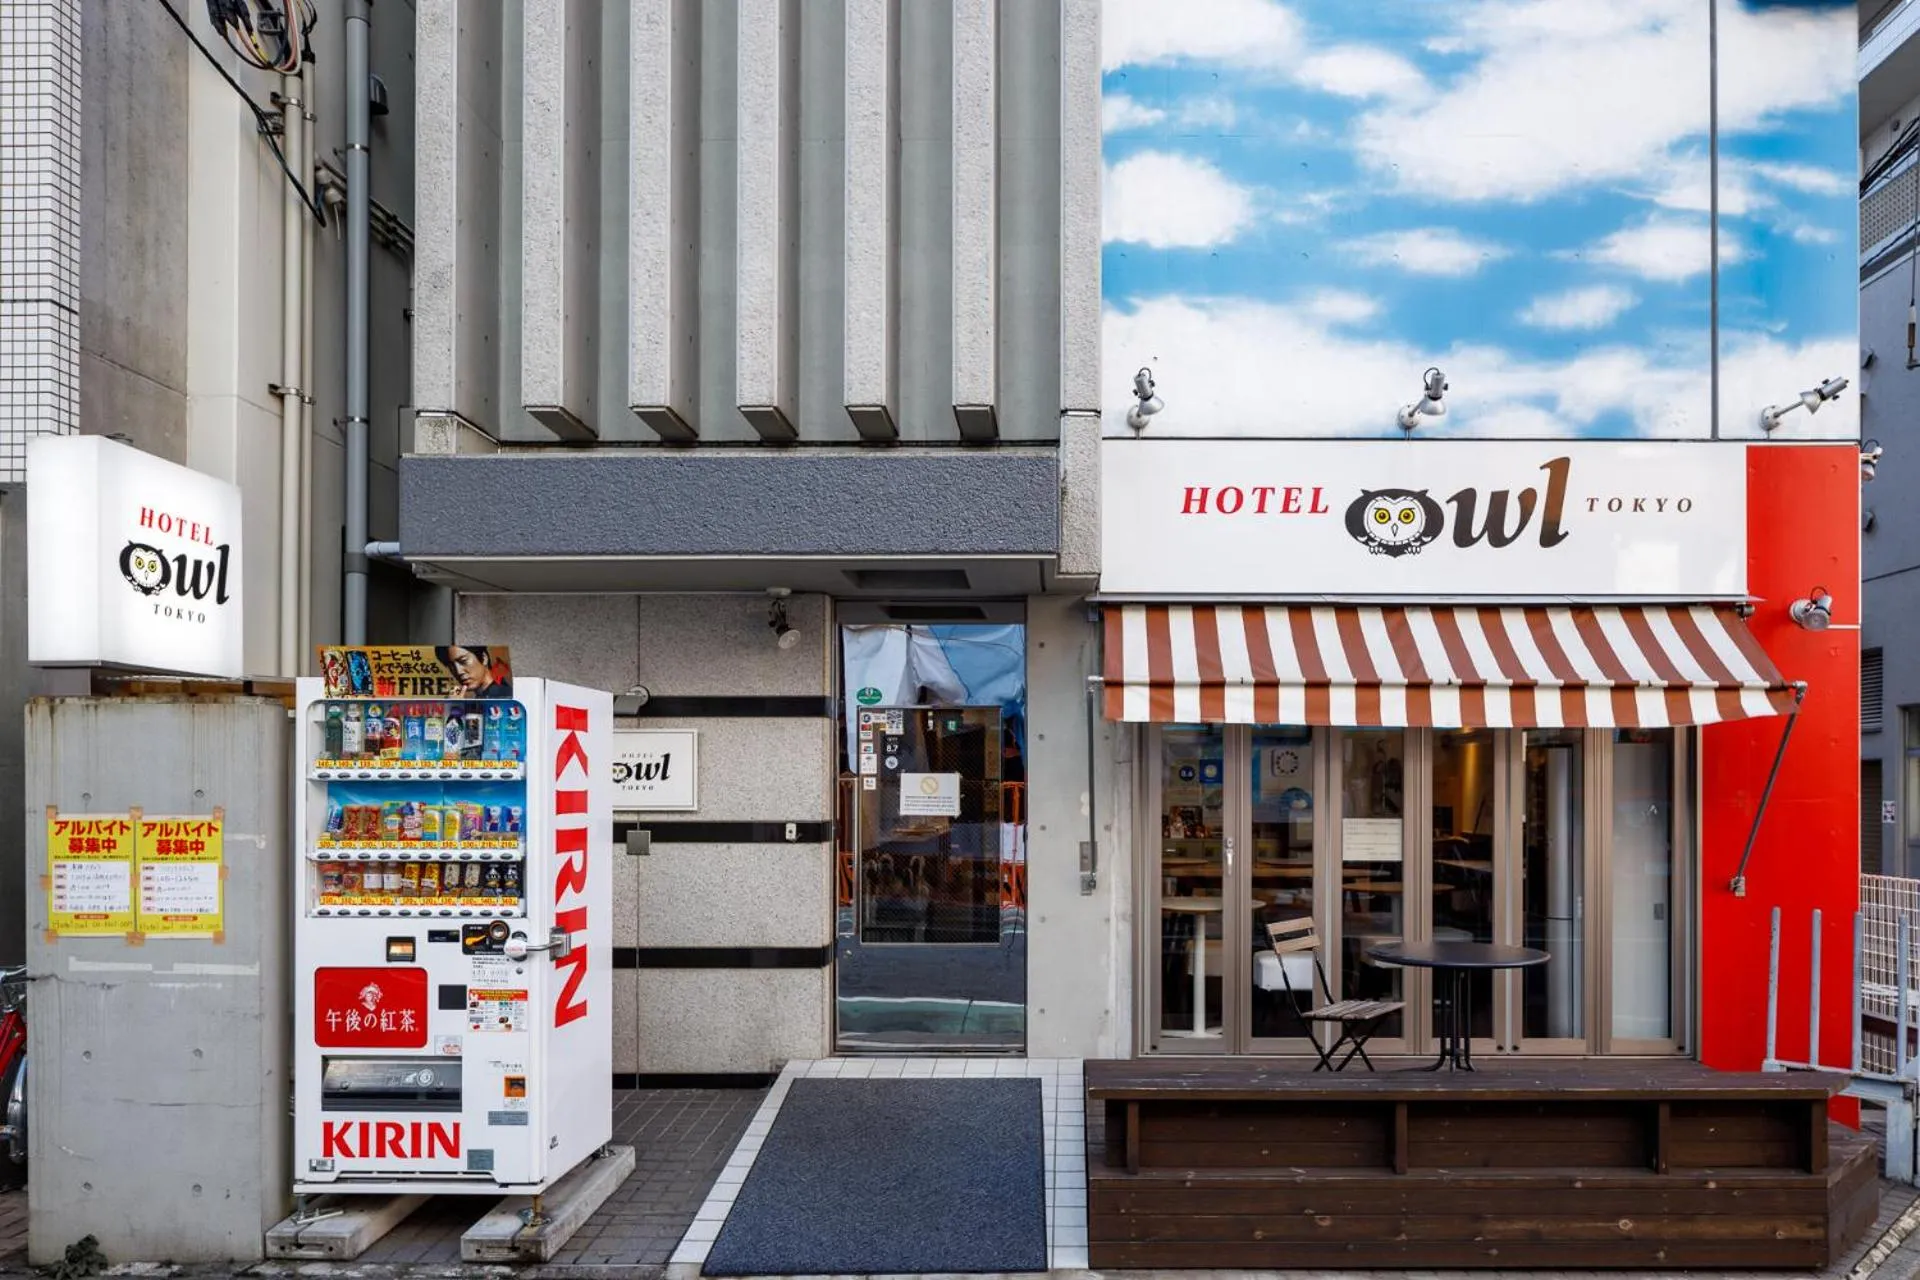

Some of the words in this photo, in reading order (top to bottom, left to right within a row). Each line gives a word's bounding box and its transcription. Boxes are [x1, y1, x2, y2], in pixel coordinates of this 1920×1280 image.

[1180, 486, 1330, 514] HOTEL
[1586, 496, 1693, 513] TOKYO
[140, 506, 214, 546] HOTEL
[153, 603, 206, 624] TOKYO
[371, 650, 422, 661] コーヒーは
[54, 820, 131, 836] アルバイト
[142, 821, 219, 838] アルバイト
[68, 837, 117, 853] 募集中
[156, 839, 205, 855] 募集中
[555, 704, 588, 1028] KIRIN
[325, 1009, 416, 1032] 午後の紅茶
[323, 1121, 461, 1159] KIRIN
